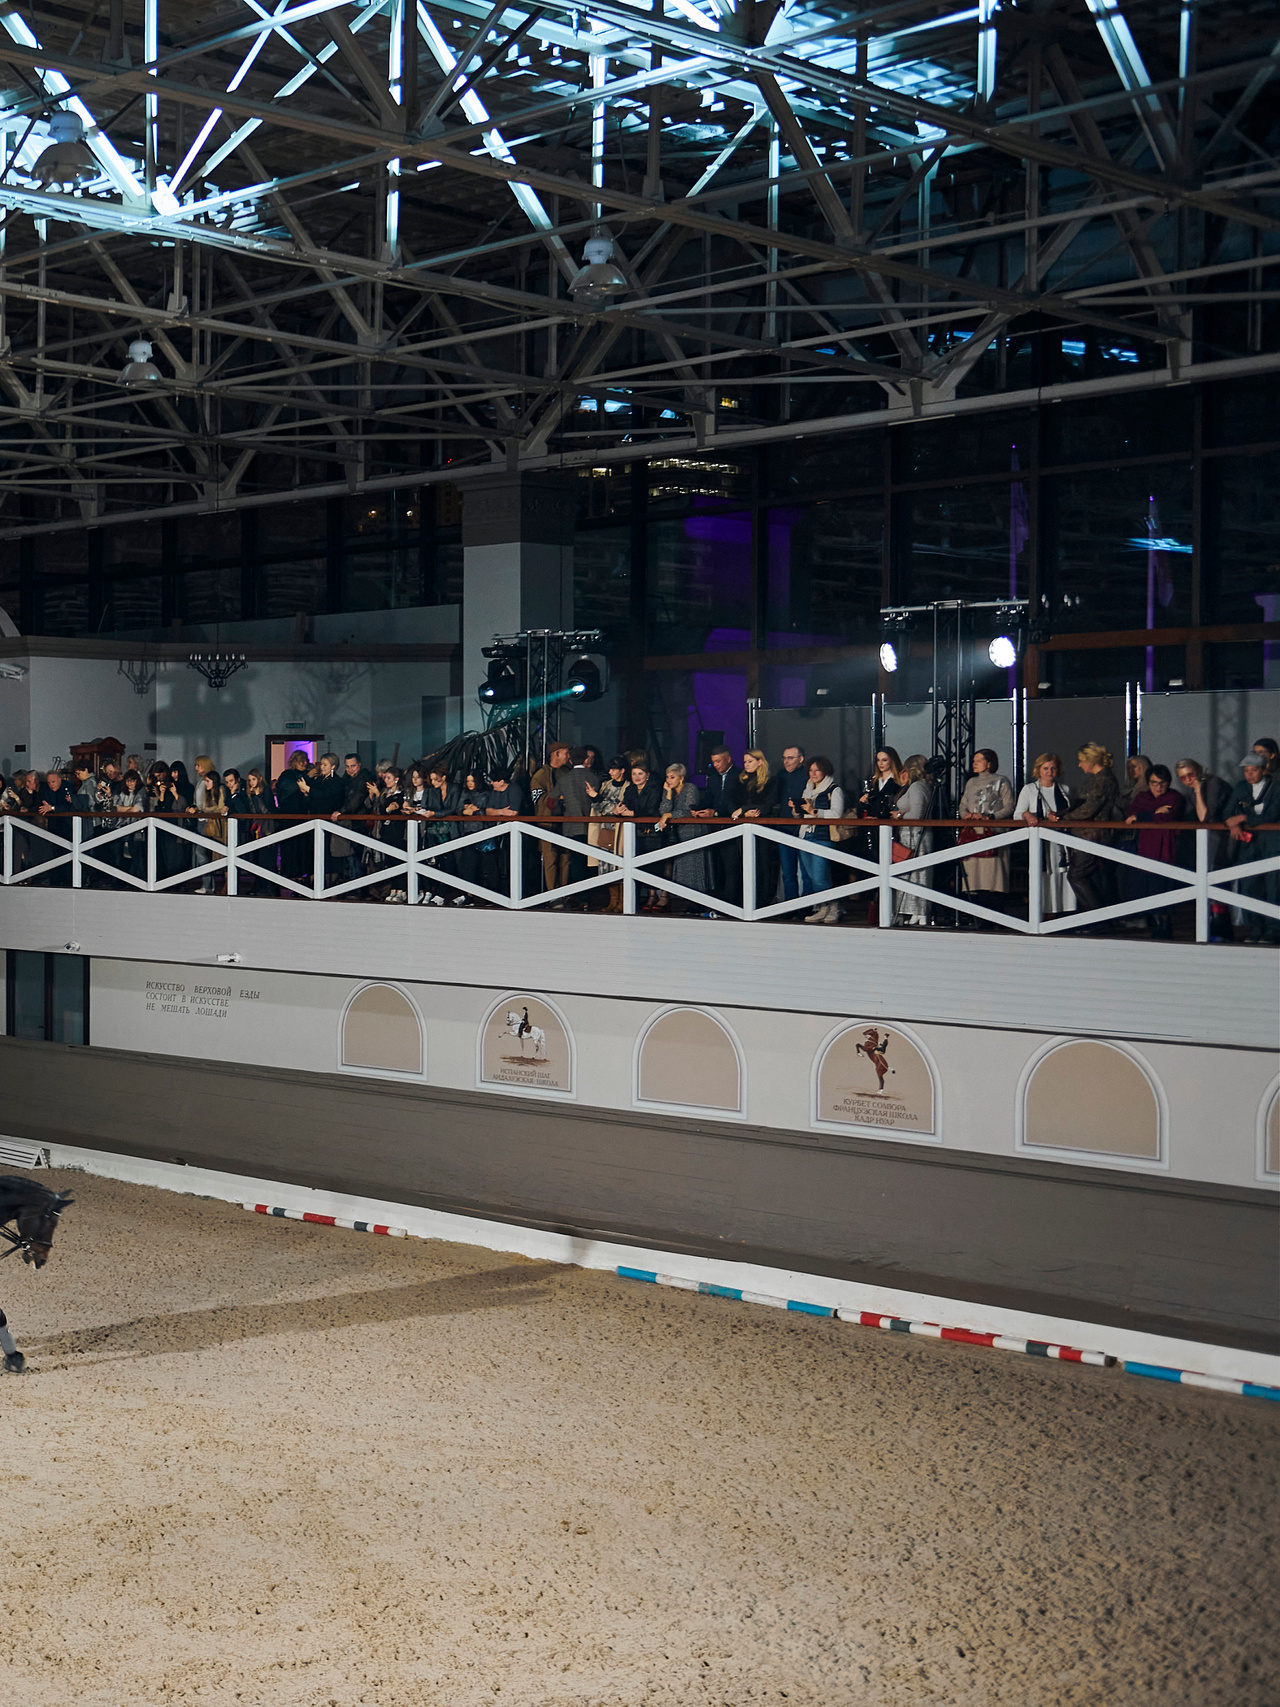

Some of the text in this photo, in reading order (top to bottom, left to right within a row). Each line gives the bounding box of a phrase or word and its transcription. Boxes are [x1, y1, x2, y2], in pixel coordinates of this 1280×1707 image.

[145, 981, 260, 999] ИСКУССТВО ВЕРХОВОЙ ЕЗДЫ
[145, 991, 229, 1007] СОСТОИТ В ИСКУССТВЕ
[145, 1002, 228, 1018] НЕ МЕШАТЬ ЛОШАДИ
[843, 1098, 871, 1108] КУРБЕТ
[832, 1104, 918, 1121] ФРАНЦУЗСКАЯ ШКОЛА
[854, 1114, 896, 1126] КАДР НУАР
